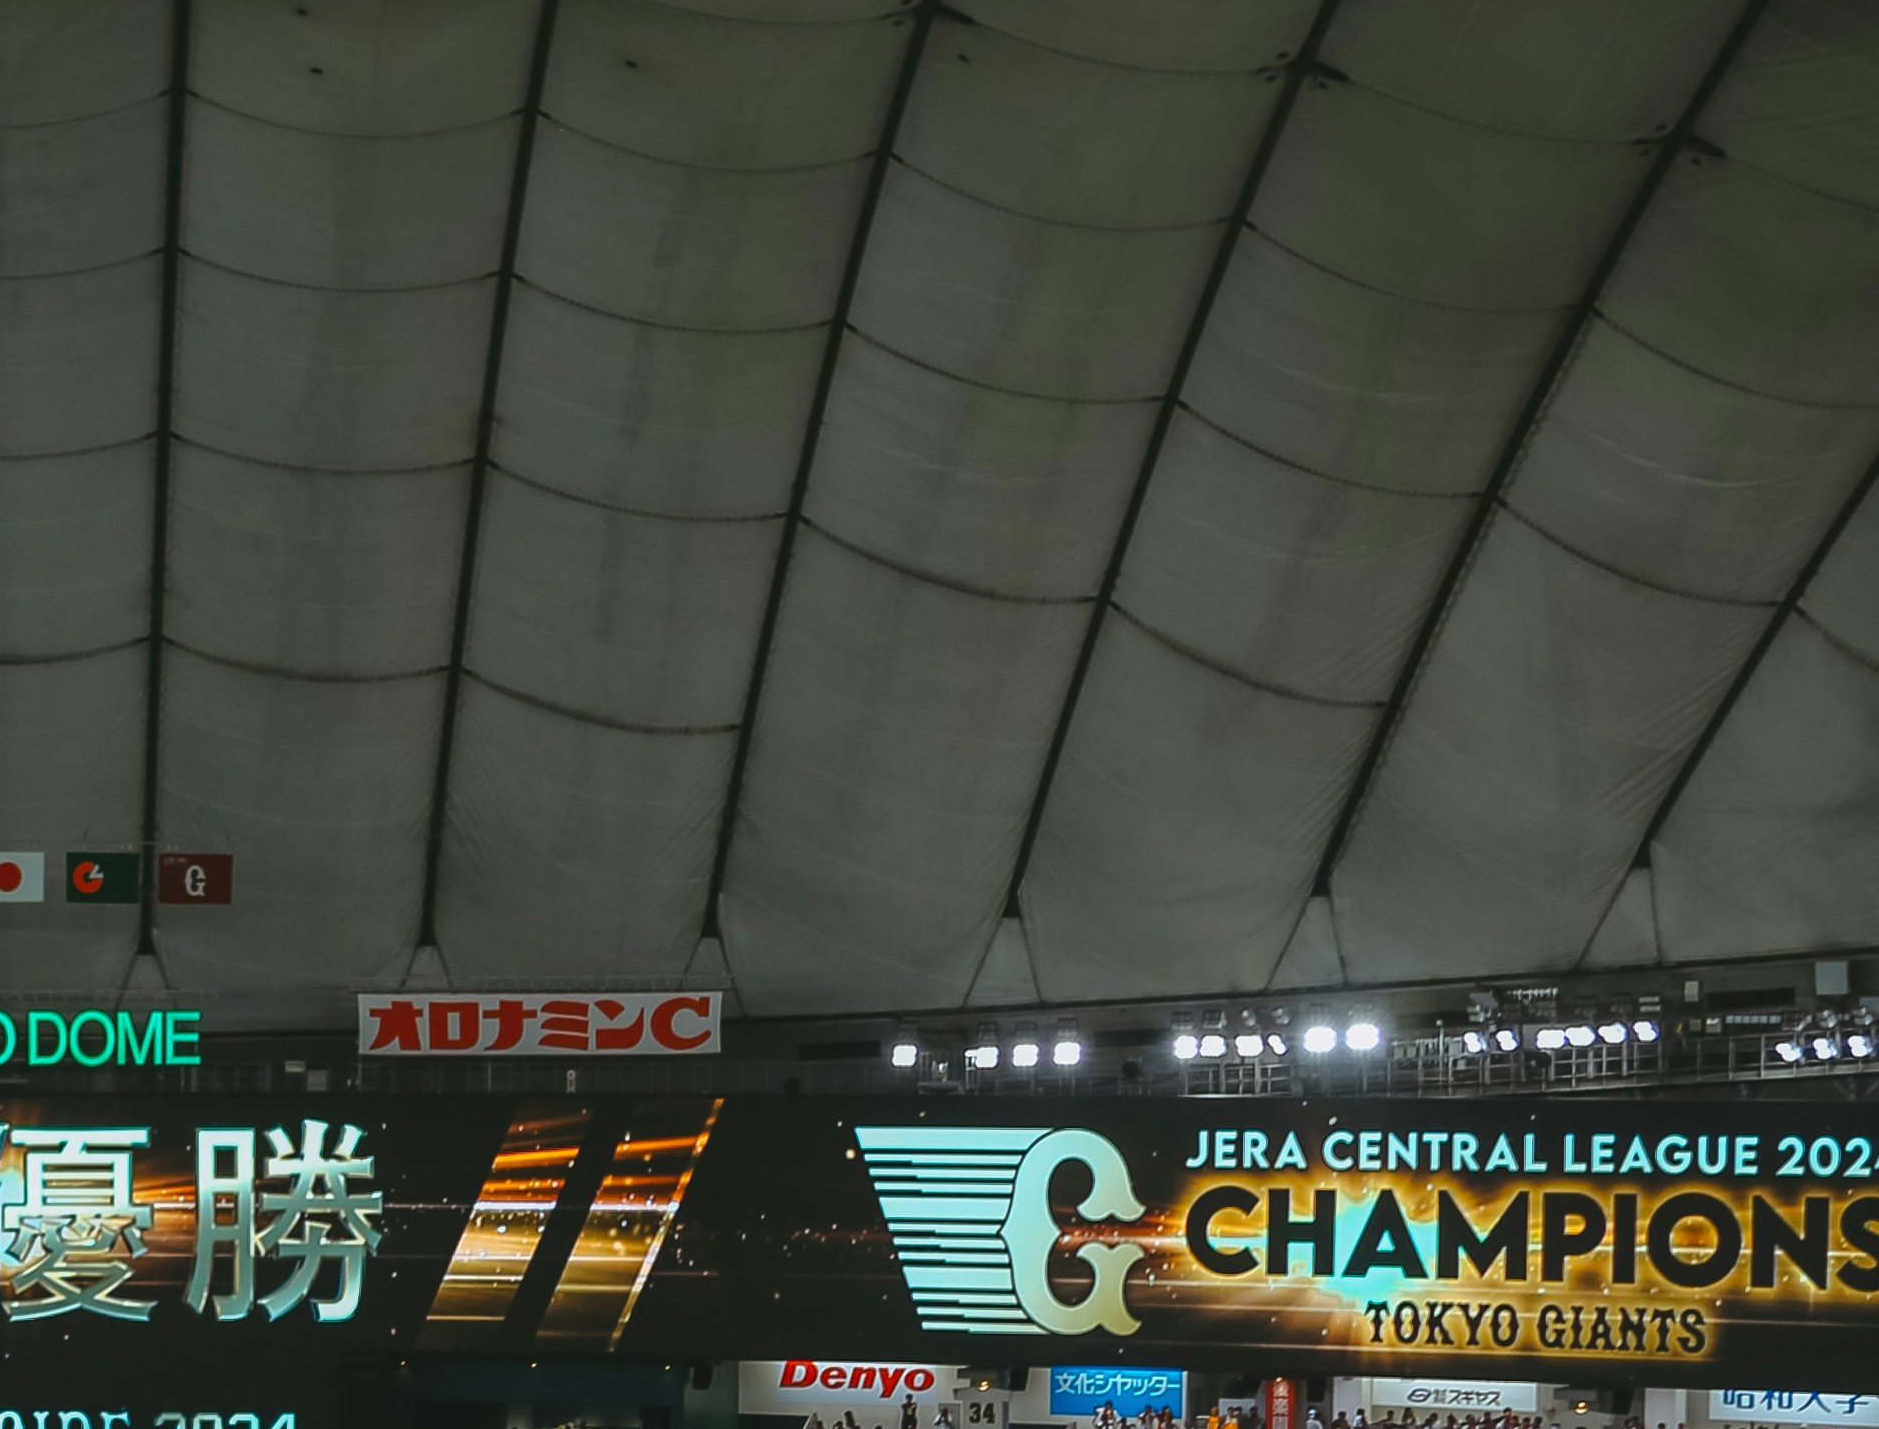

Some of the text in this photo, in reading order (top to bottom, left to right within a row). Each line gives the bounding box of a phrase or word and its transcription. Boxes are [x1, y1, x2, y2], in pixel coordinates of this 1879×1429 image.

[27, 1008, 202, 1067] DOME
[368, 995, 713, 1051] オロナミンC
[1185, 1129, 1879, 1178] JERA CENTRAL LEAGUE 202
[1365, 1300, 1707, 1355] TOKYO GIANTS
[779, 1358, 935, 1399] Denyo
[968, 1401, 996, 1424] 34
